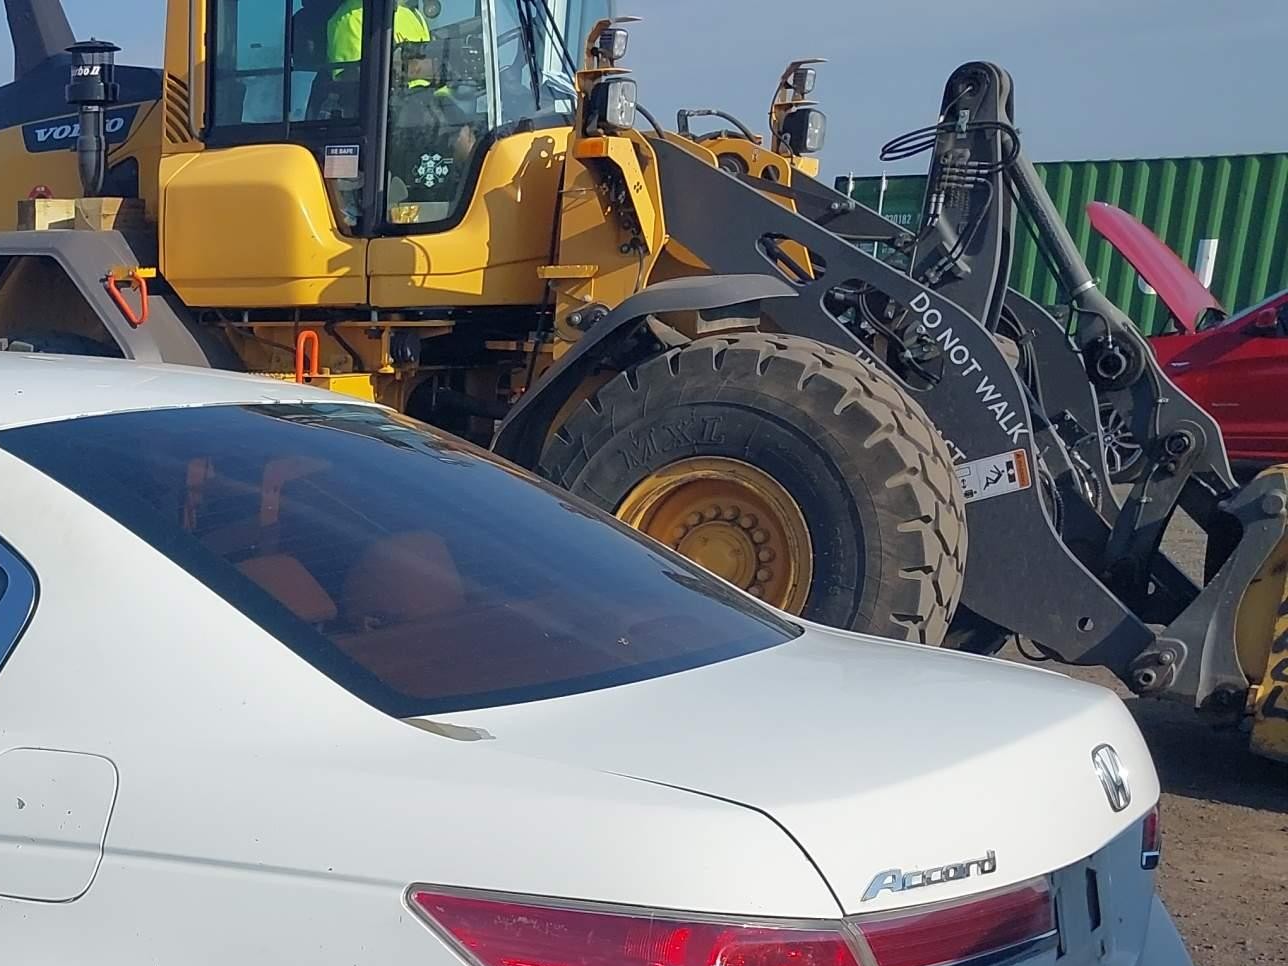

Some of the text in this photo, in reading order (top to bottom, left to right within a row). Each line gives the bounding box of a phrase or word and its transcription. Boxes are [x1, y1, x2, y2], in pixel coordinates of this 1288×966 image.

[35, 117, 124, 142] VOLO
[909, 291, 1029, 444] DO NOT WALK
[861, 850, 997, 902] Accord
